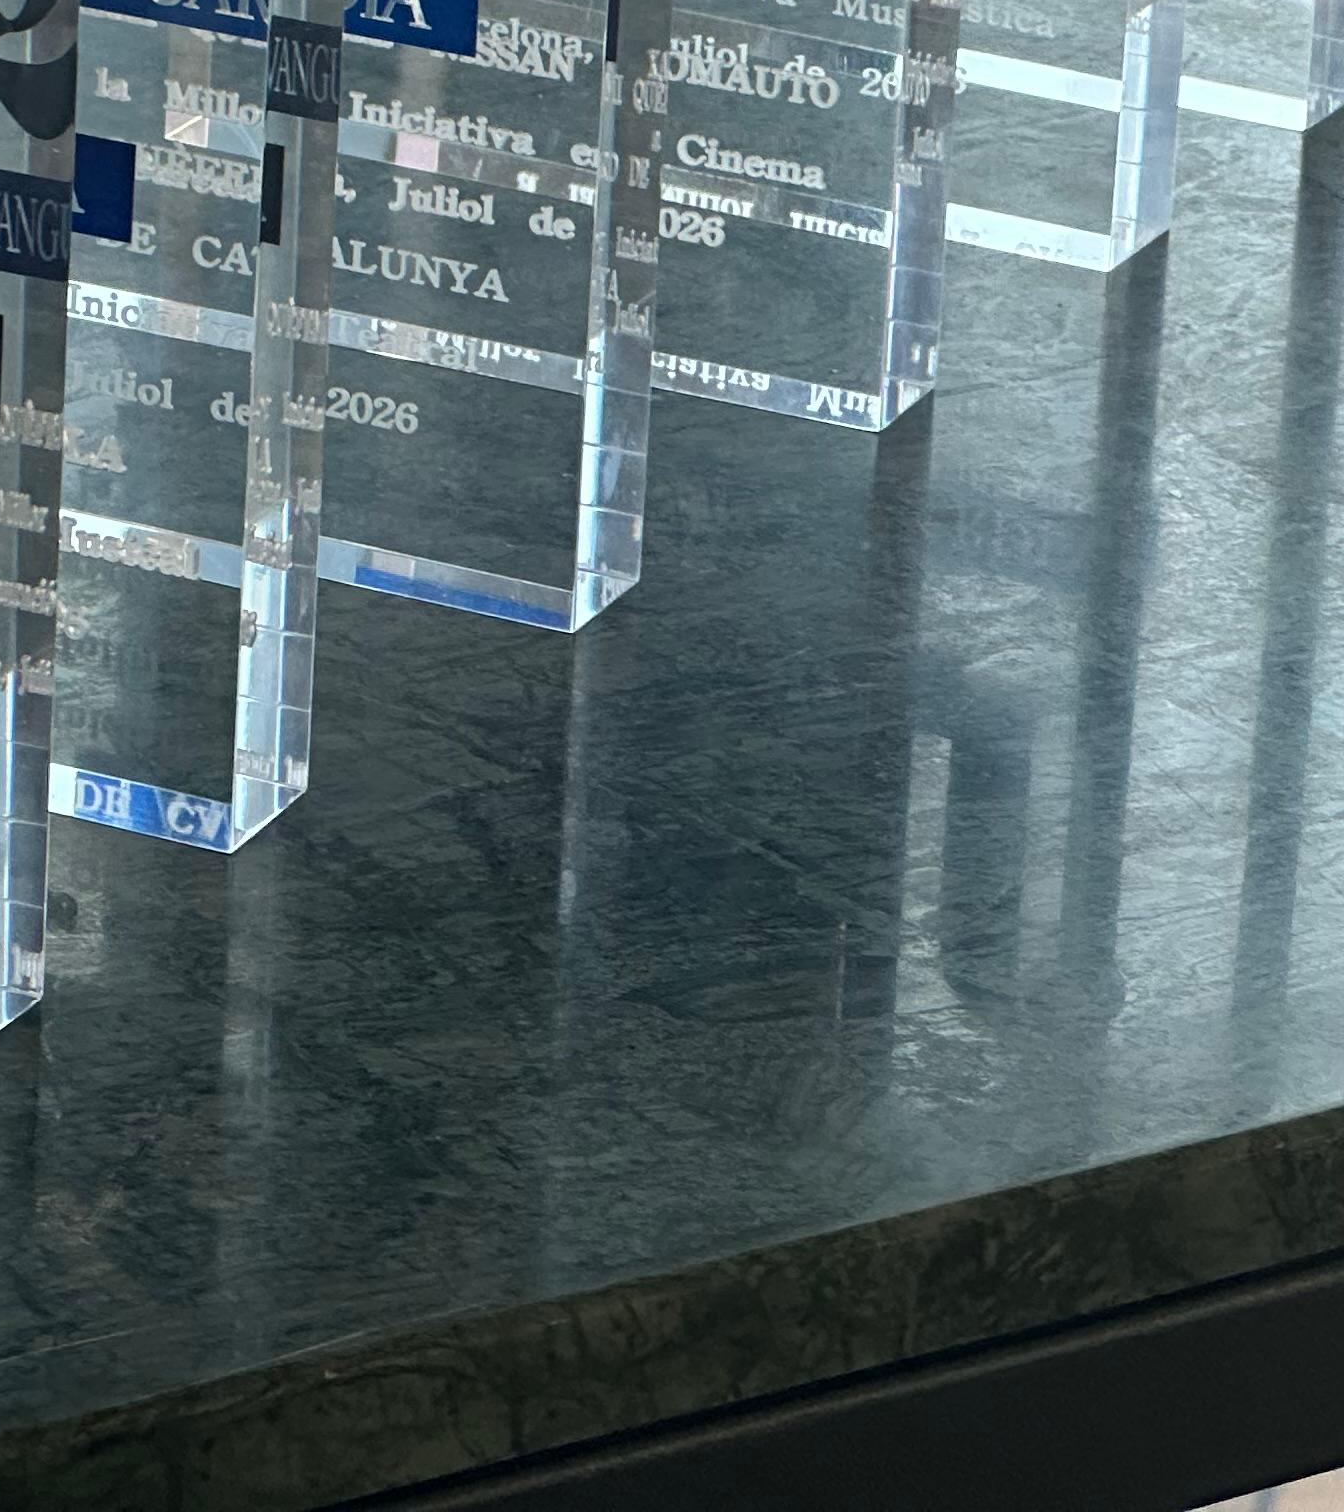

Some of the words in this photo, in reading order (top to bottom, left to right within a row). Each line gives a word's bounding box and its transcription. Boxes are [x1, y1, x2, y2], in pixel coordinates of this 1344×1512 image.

[95, 66, 132, 102] la
[163, 79, 263, 127] Millo
[348, 90, 537, 157] Iniciativa
[676, 133, 827, 191] Cinema
[387, 175, 496, 227] Juliol
[528, 205, 576, 241] de
[658, 206, 727, 248] 026
[191, 234, 511, 304] CAALUNYA
[210, 392, 252, 428] de
[325, 386, 420, 435] 2026
